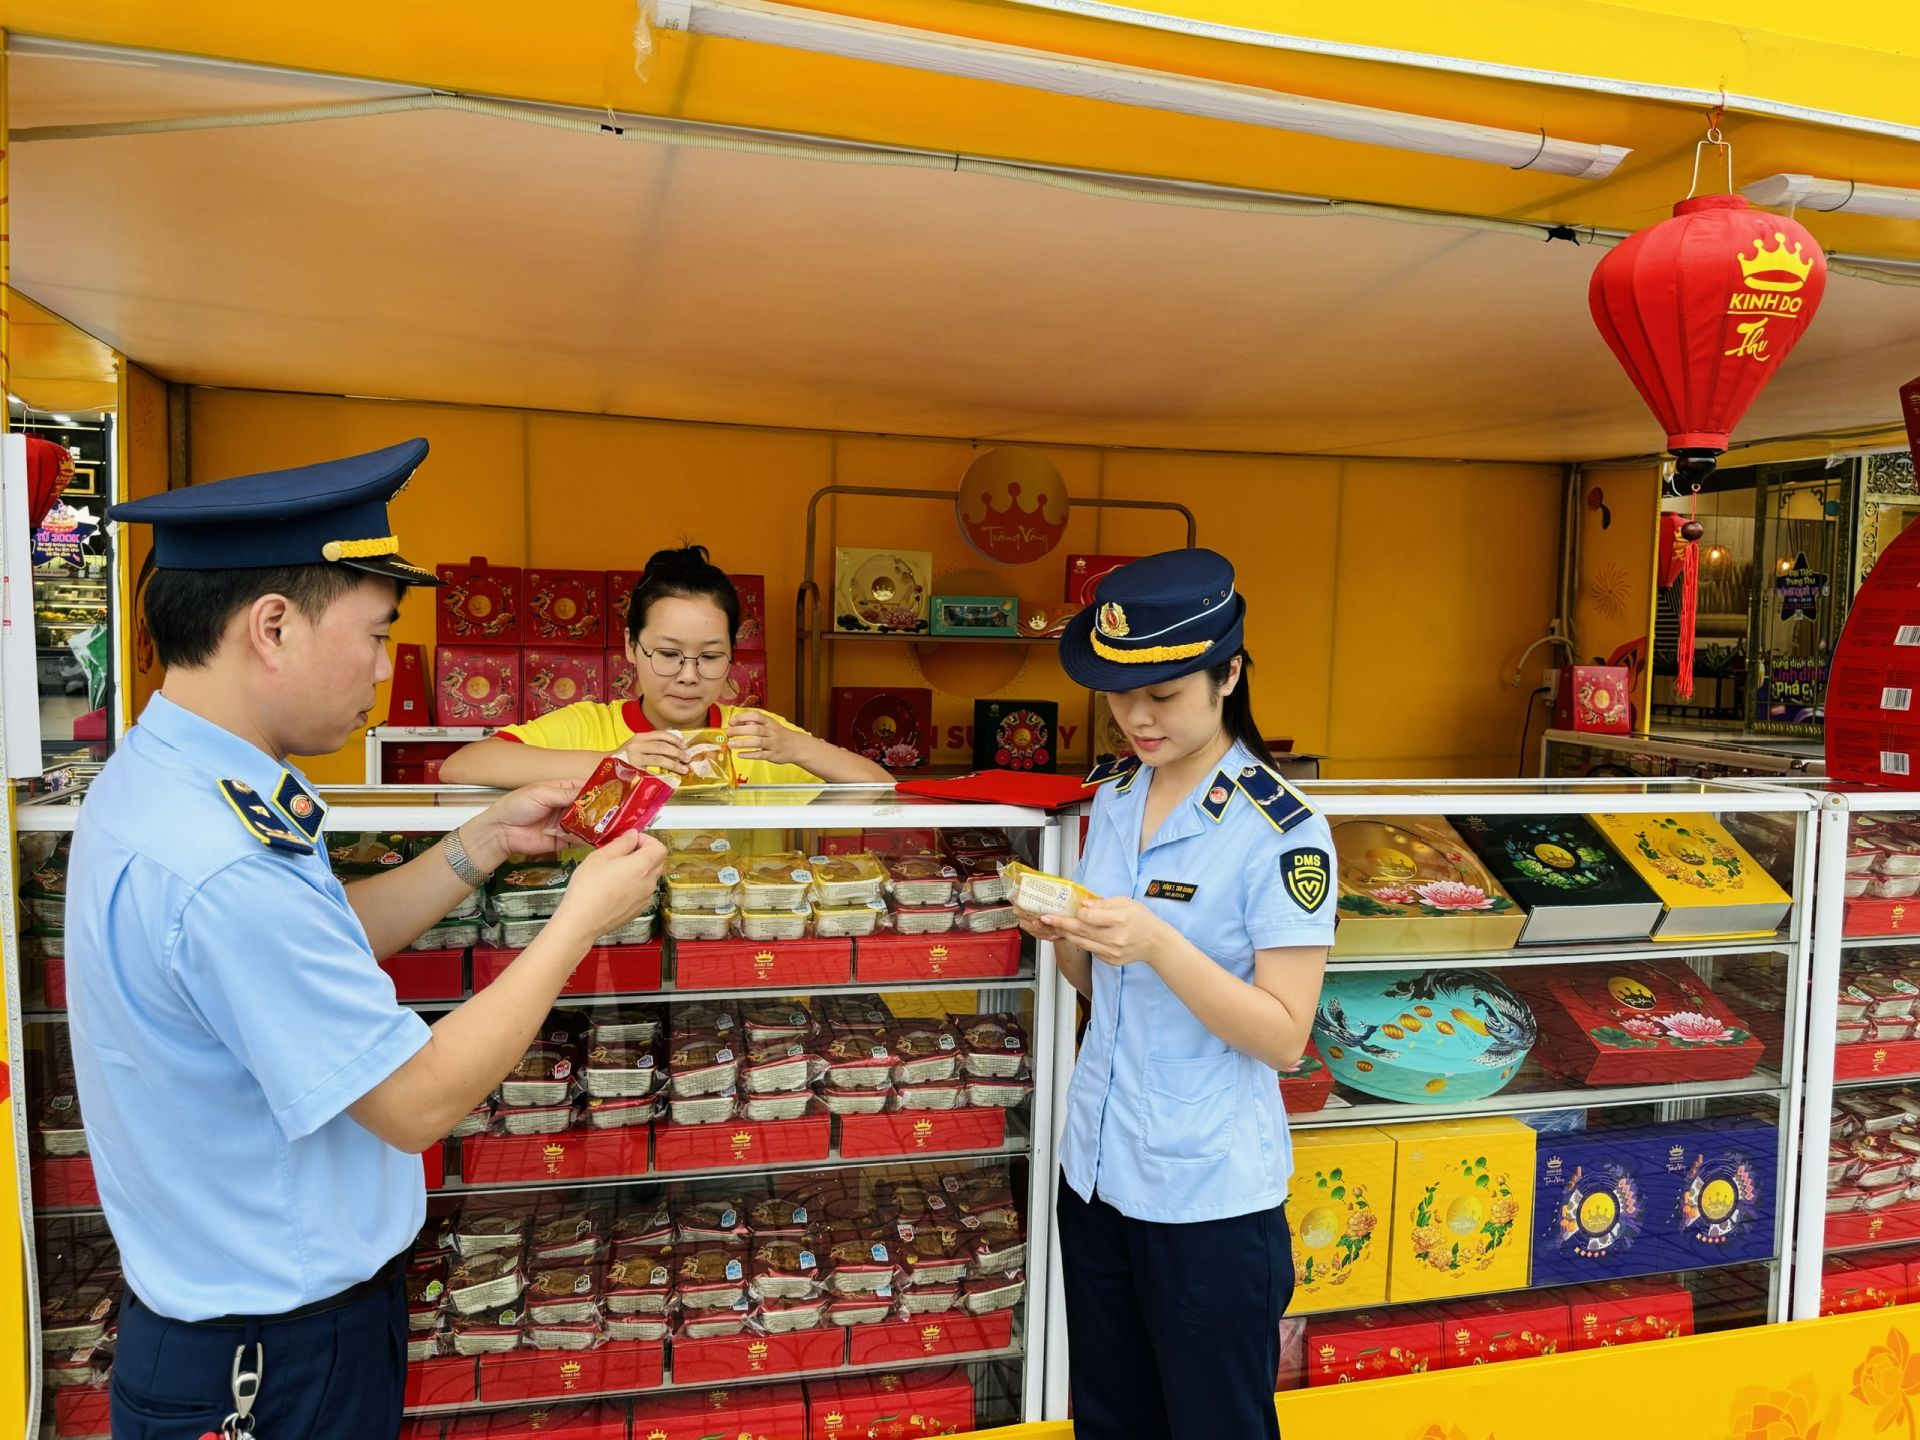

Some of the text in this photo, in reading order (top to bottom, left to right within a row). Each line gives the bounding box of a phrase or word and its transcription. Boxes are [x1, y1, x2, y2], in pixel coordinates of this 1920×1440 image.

[1728, 293, 1803, 313] KINH DO
[1724, 317, 1772, 362] Thu
[1294, 855, 1321, 867] DMS
